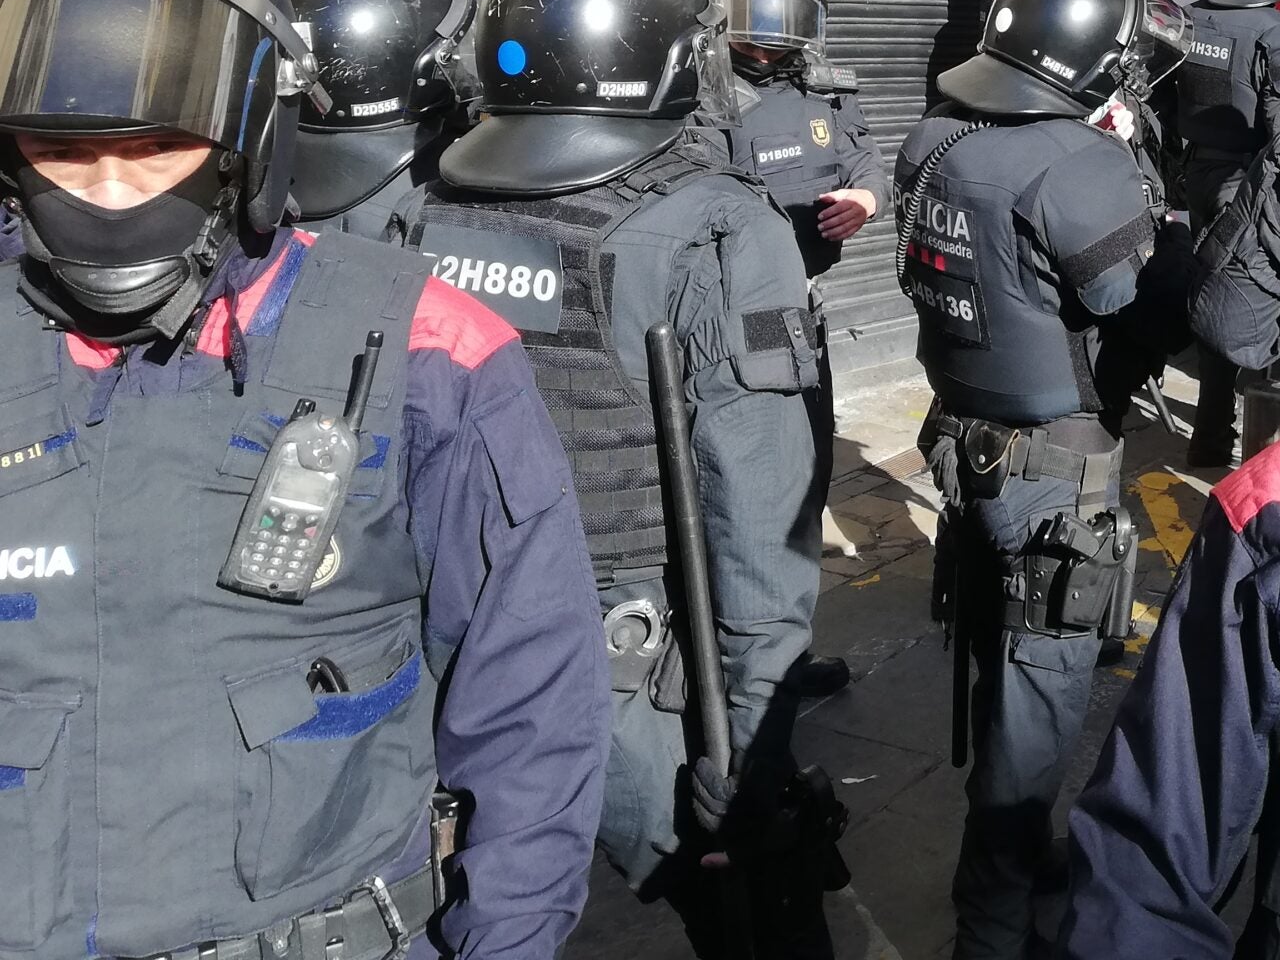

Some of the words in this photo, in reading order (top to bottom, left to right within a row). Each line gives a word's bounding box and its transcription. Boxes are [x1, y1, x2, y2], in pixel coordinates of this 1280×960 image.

[1190, 40, 1229, 60] 1H336
[599, 82, 646, 97] D2H880
[353, 99, 399, 117] D2D555
[759, 145, 802, 163] D1B002
